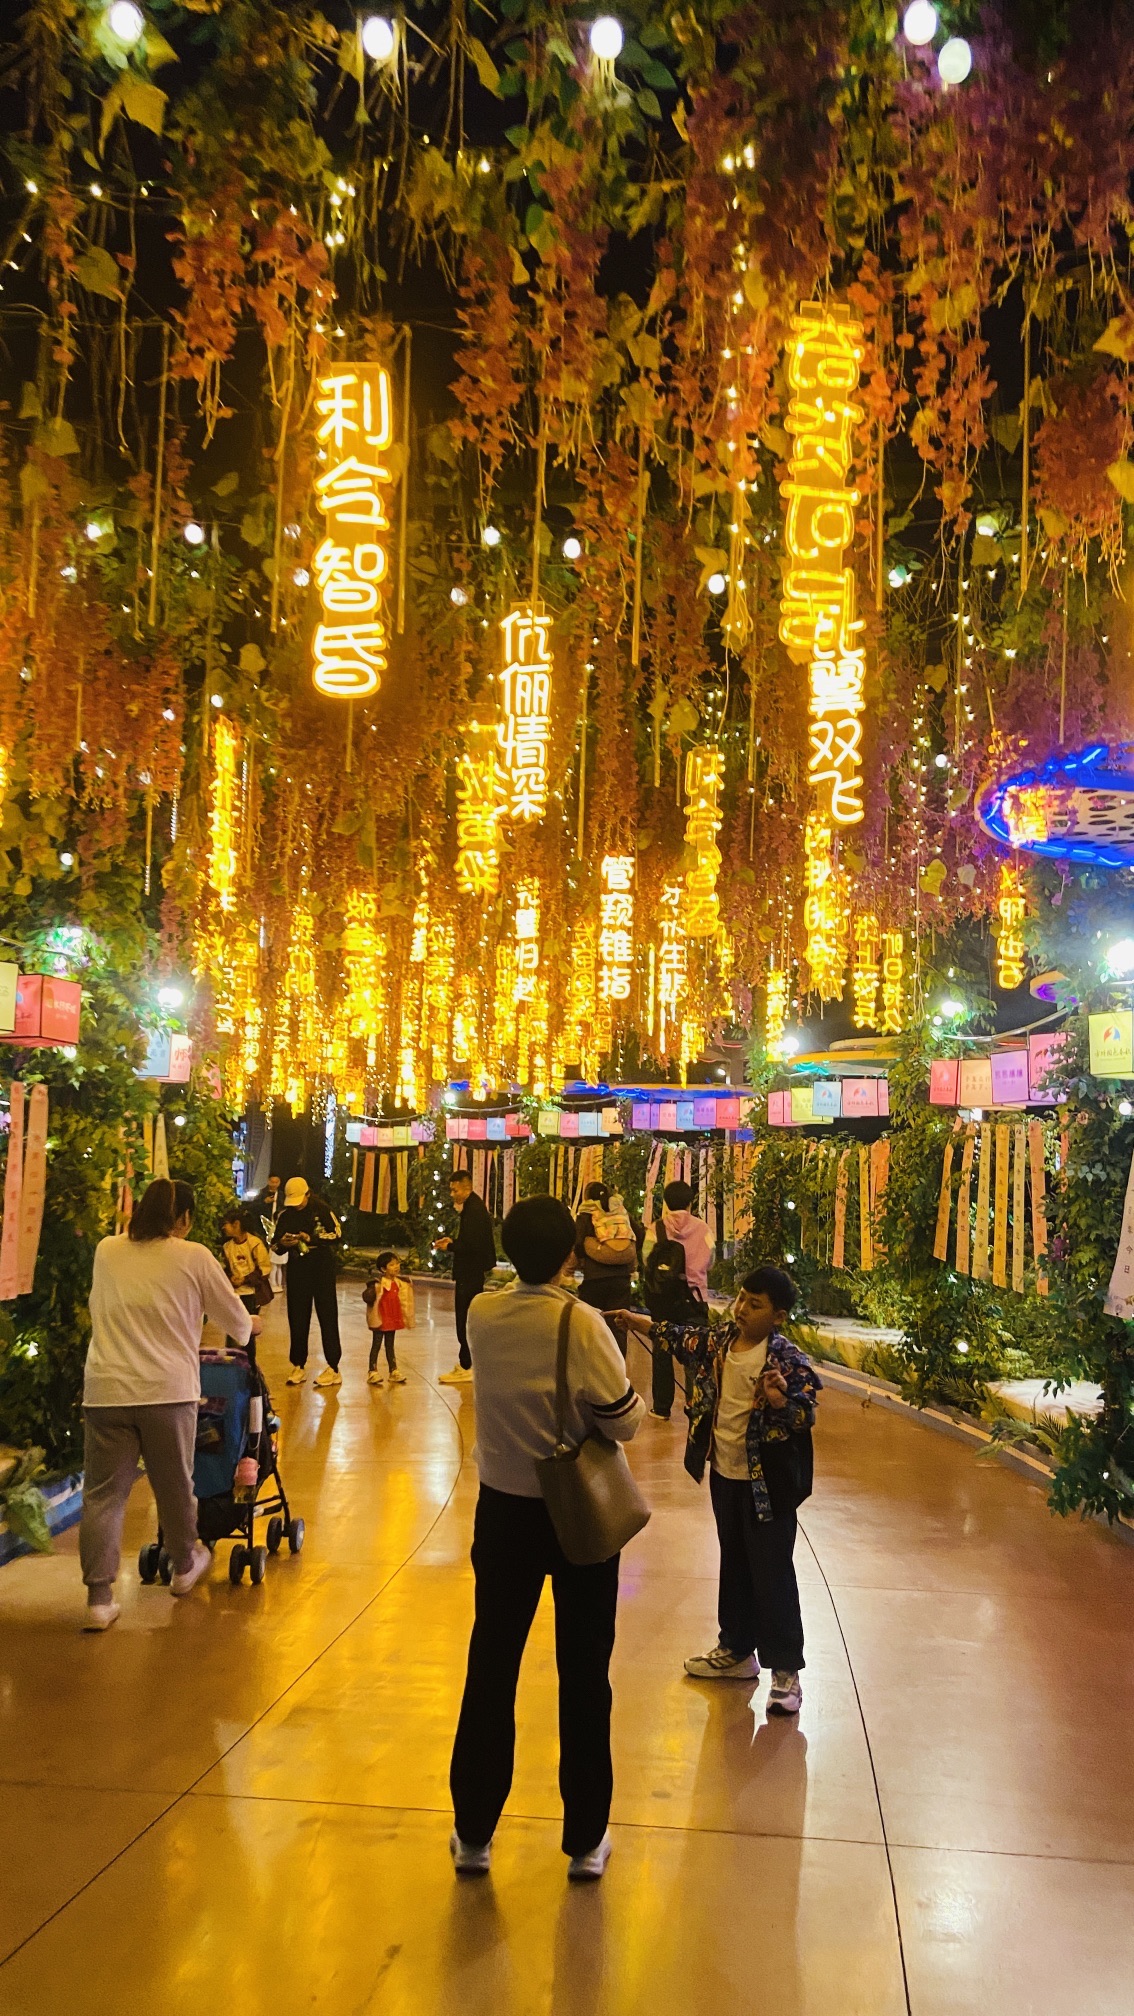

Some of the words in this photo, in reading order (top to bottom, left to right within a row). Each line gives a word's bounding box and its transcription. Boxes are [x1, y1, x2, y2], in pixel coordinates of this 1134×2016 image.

[312, 367, 392, 699] 利令智昏
[498, 608, 553, 819] 伉俪情深
[808, 611, 866, 825] 比翼双飞
[513, 876, 542, 1004] 完璧归赵
[598, 854, 636, 1000] 管窥锥指
